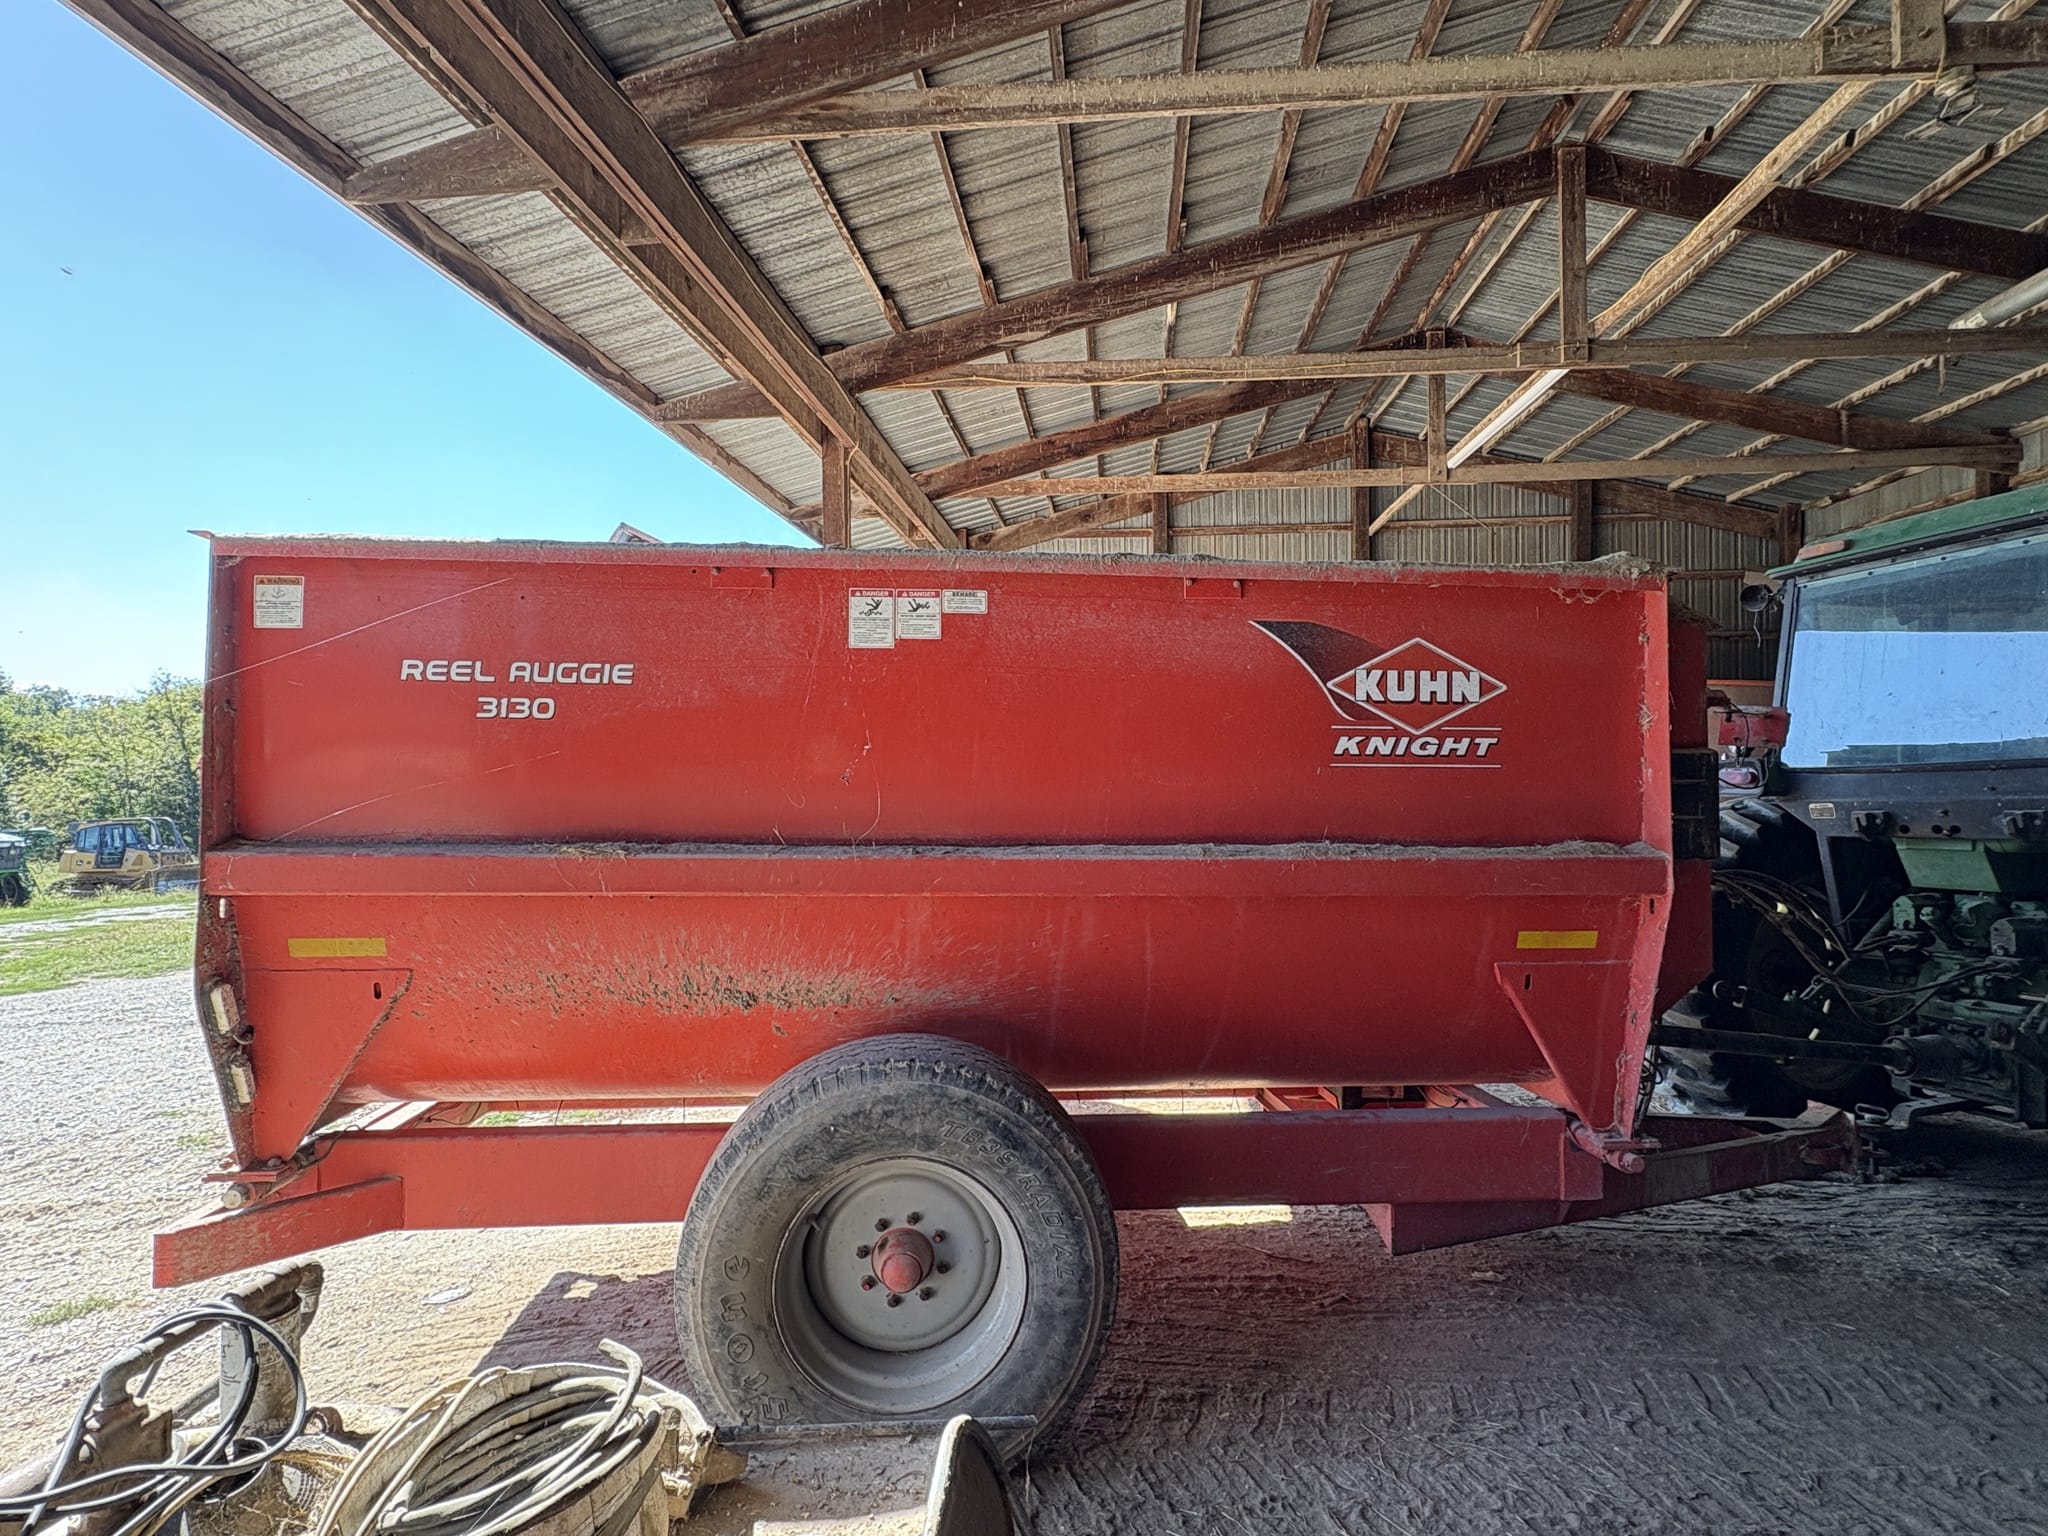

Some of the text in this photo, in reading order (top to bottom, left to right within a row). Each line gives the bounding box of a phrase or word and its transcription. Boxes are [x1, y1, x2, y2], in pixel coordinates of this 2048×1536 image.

[400, 659, 635, 685] REEL AUGGIE
[1354, 669, 1481, 704] KUHN
[475, 696, 556, 720] 3130
[1333, 735, 1499, 758] KNIGHT
[1016, 1172, 1075, 1279] RADIAL
